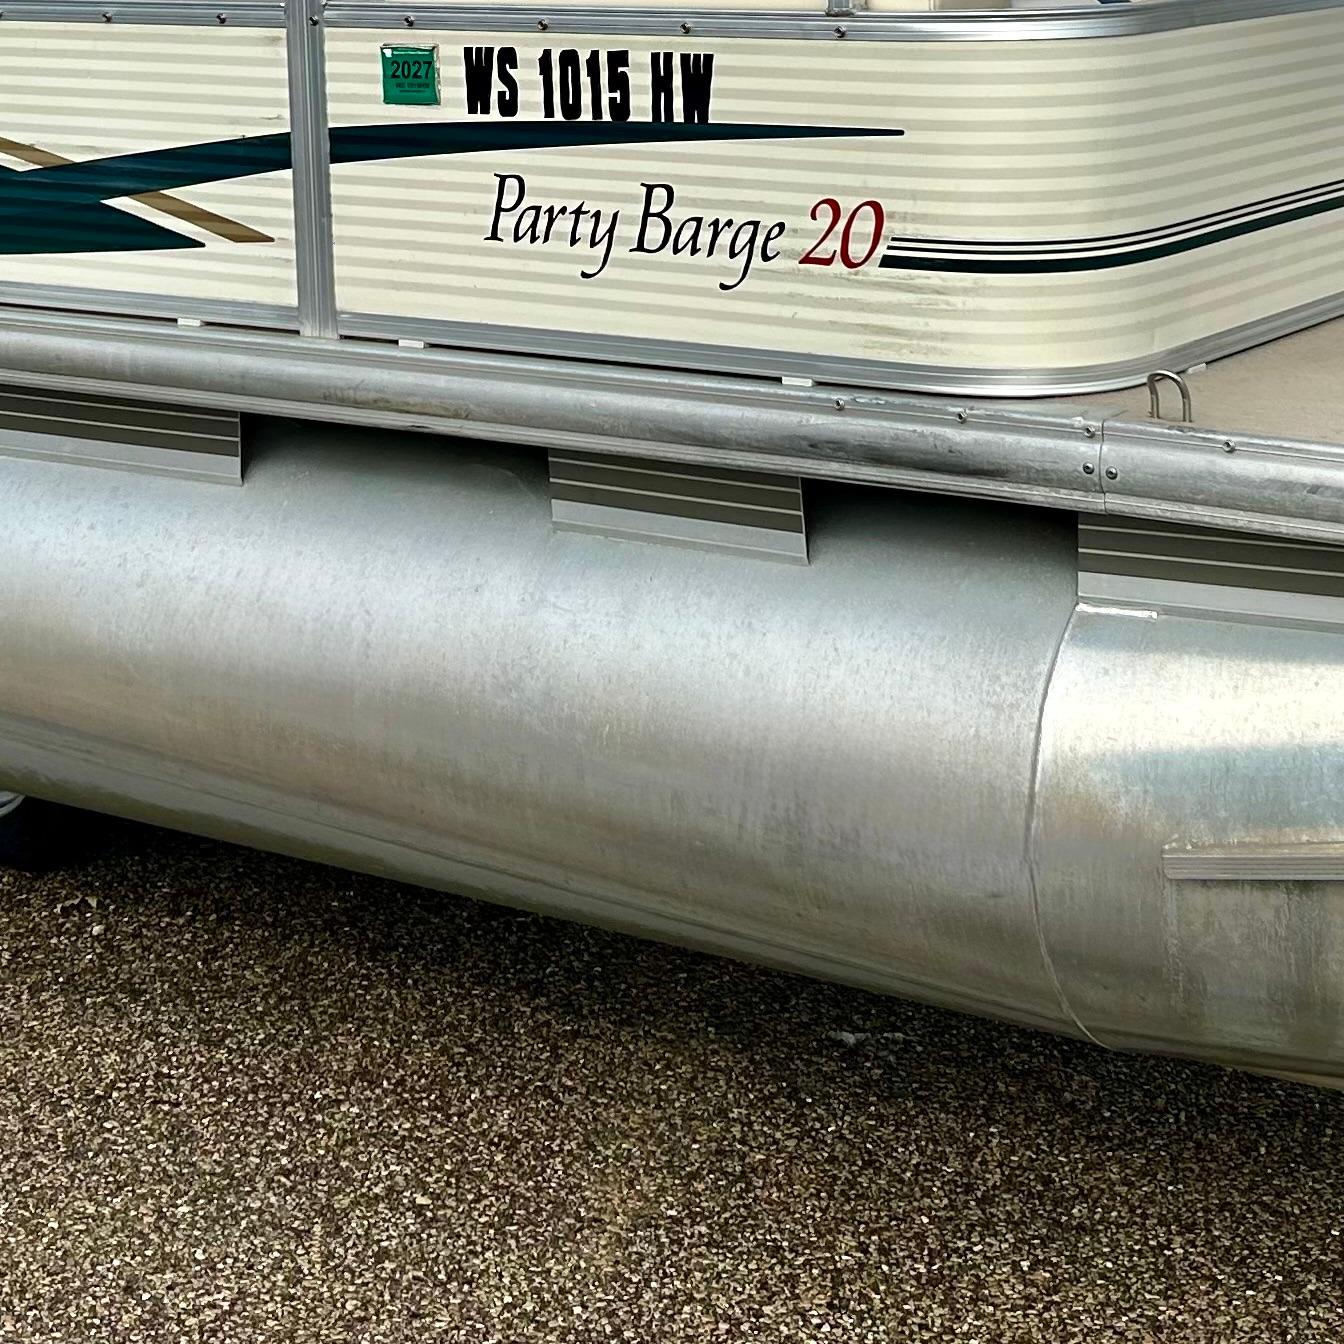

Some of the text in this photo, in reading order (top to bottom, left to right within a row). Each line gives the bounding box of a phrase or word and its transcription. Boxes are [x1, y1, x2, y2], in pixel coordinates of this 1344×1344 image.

[390, 60, 433, 79] 2027
[463, 46, 714, 124] WS 1015 HW
[483, 172, 885, 291] Party Barge 20
